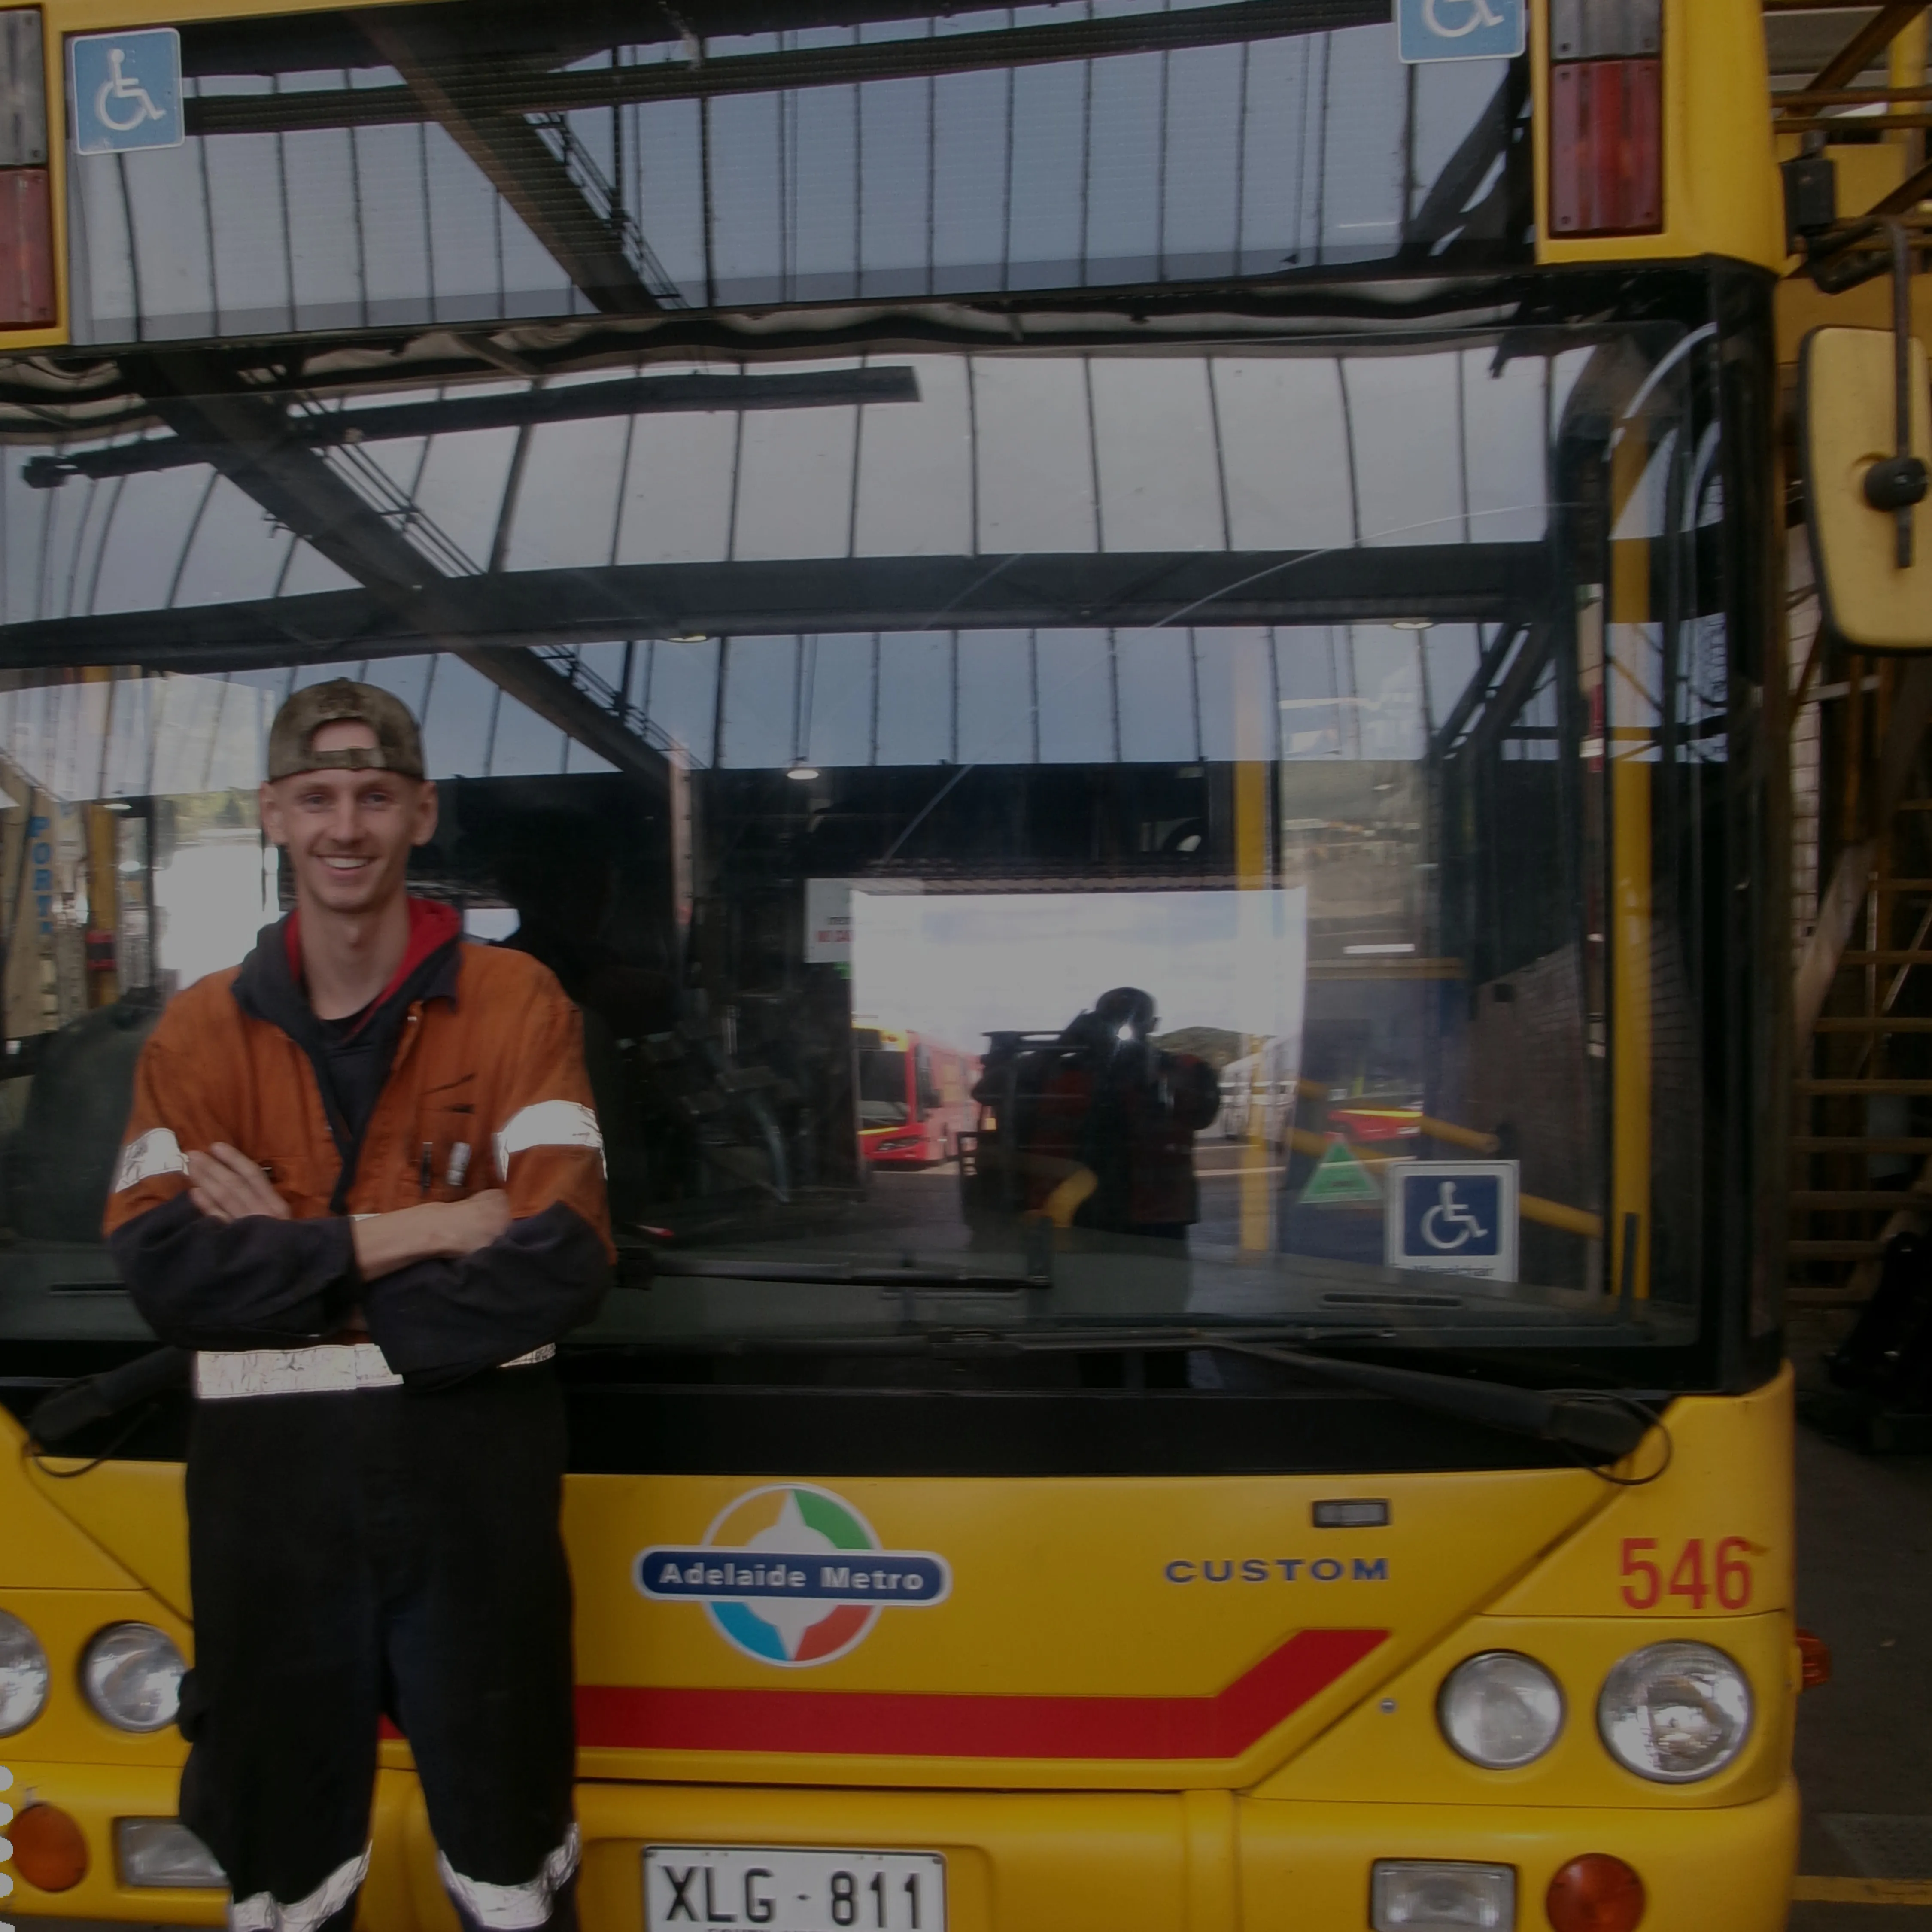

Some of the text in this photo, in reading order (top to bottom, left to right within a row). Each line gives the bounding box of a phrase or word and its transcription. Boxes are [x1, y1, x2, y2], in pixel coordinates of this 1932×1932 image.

[658, 1562, 924, 1591] Adelaide Metro
[1165, 1558, 1390, 1583] CUSTOM
[1621, 1536, 1752, 1609] 546
